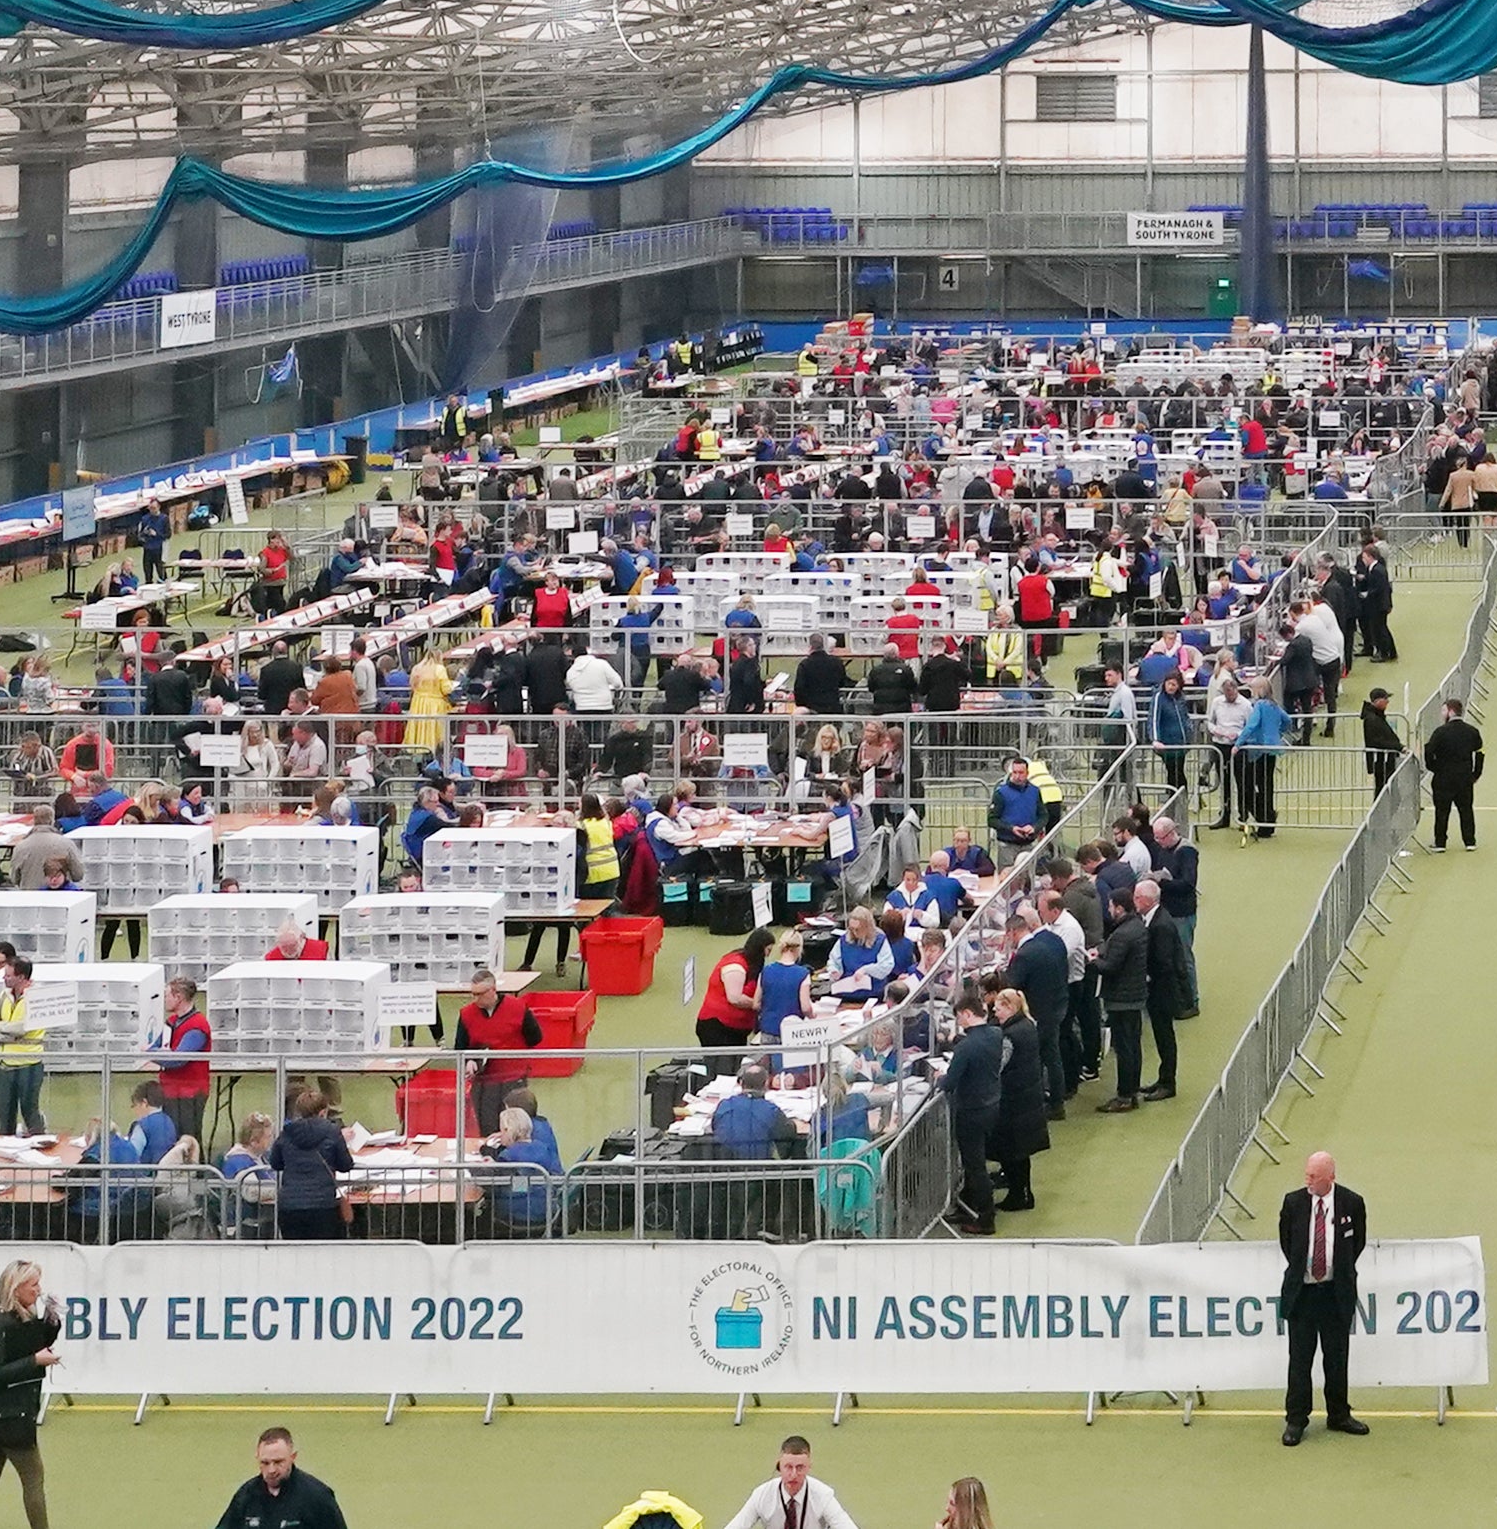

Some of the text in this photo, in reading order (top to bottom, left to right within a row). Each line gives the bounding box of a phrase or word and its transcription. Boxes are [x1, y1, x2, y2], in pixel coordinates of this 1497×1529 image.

[1135, 219, 1214, 230] FERMANAGH &
[1135, 230, 1216, 241] SOUTH TYRONE
[942, 269, 955, 288] 4
[167, 310, 211, 329] WEST TYRONE
[792, 1026, 828, 1038] NEWRY
[689, 1262, 793, 1308] THE ELECTORAL OFFICE
[166, 1296, 392, 1340] ELECTION
[411, 1296, 523, 1340] 2022
[812, 1290, 1487, 1340] NI ASSEMBLY ELECTN 202
[689, 1325, 793, 1375] FOR NORTHERN IRELAND
